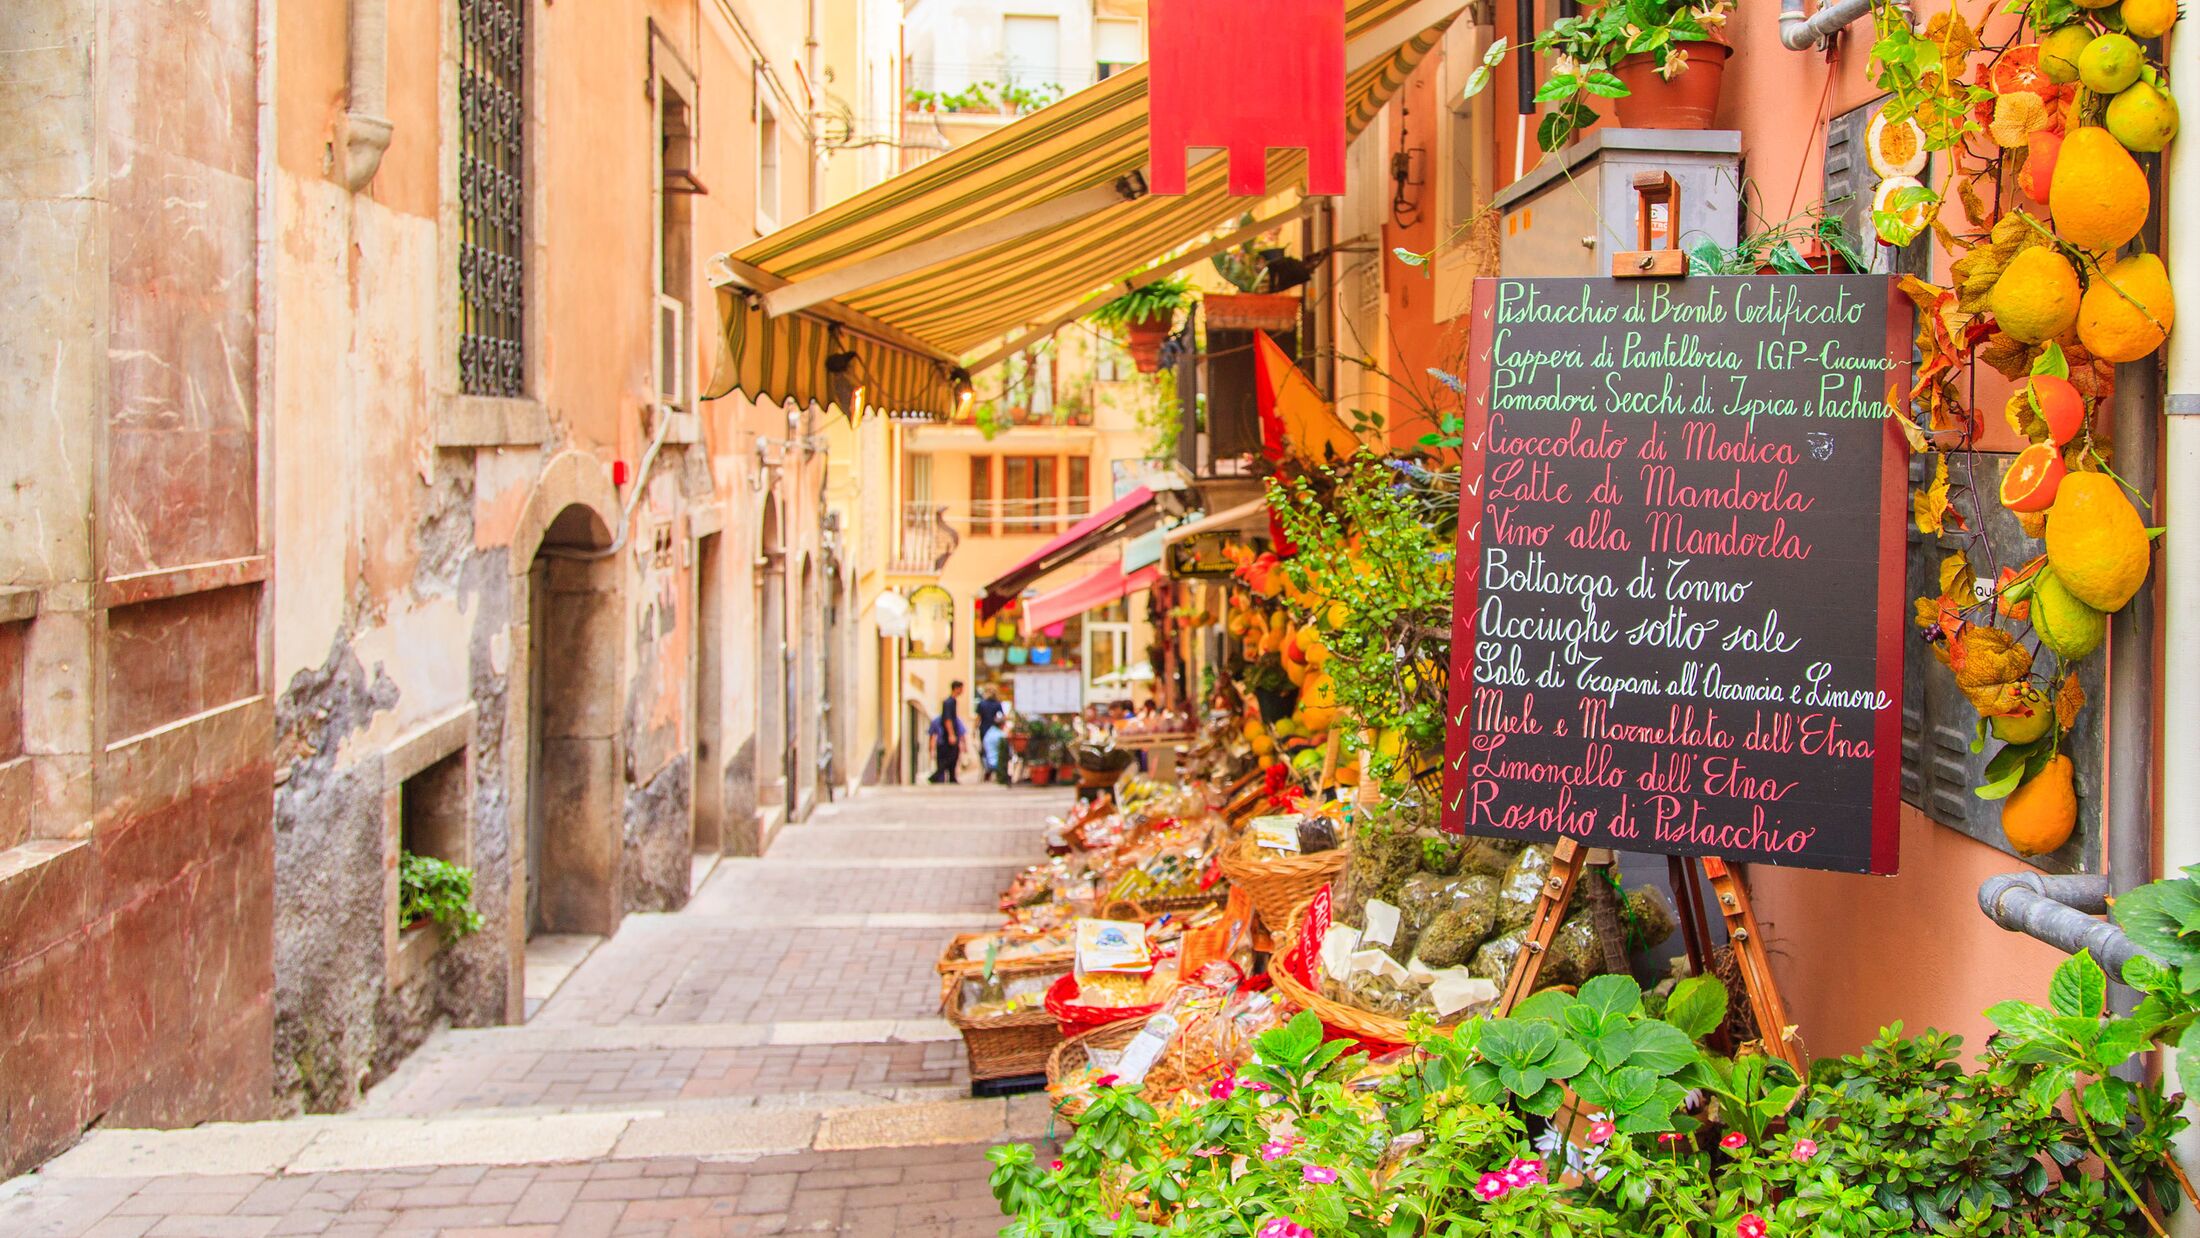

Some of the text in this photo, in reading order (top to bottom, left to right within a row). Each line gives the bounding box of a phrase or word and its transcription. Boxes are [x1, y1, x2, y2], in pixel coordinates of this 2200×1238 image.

[1499, 283, 1865, 335] Pistacchio di Bronte Certificato
[1494, 330, 1584, 383] Capperi
[1590, 335, 1614, 367] di
[1623, 333, 1742, 370] Pantelleria
[1491, 368, 1597, 412] Pomodori
[1605, 373, 1685, 414] Secchi
[1690, 376, 1714, 414] di
[1803, 400, 1813, 415] e
[1488, 415, 1800, 464] Cioccolato di Modica
[1489, 460, 1815, 511] Latte di Mandorla
[1487, 505, 1813, 558] Vino alla Mandorla
[1486, 549, 1753, 610] Bottarga di Tonno
[1481, 597, 1802, 664] Acciughe sotto sale
[1474, 644, 1529, 686] Sale
[1536, 652, 1565, 687] di
[1577, 654, 1661, 707] Trapani
[1790, 688, 1801, 702] e
[1806, 662, 1893, 710] Limone
[1474, 689, 1542, 735] Miele
[1553, 719, 1568, 736] e
[1579, 698, 1735, 747] Marmellata
[1472, 736, 1626, 788] Limoncello
[1471, 781, 1816, 852] Rosolio di Pistacchio
